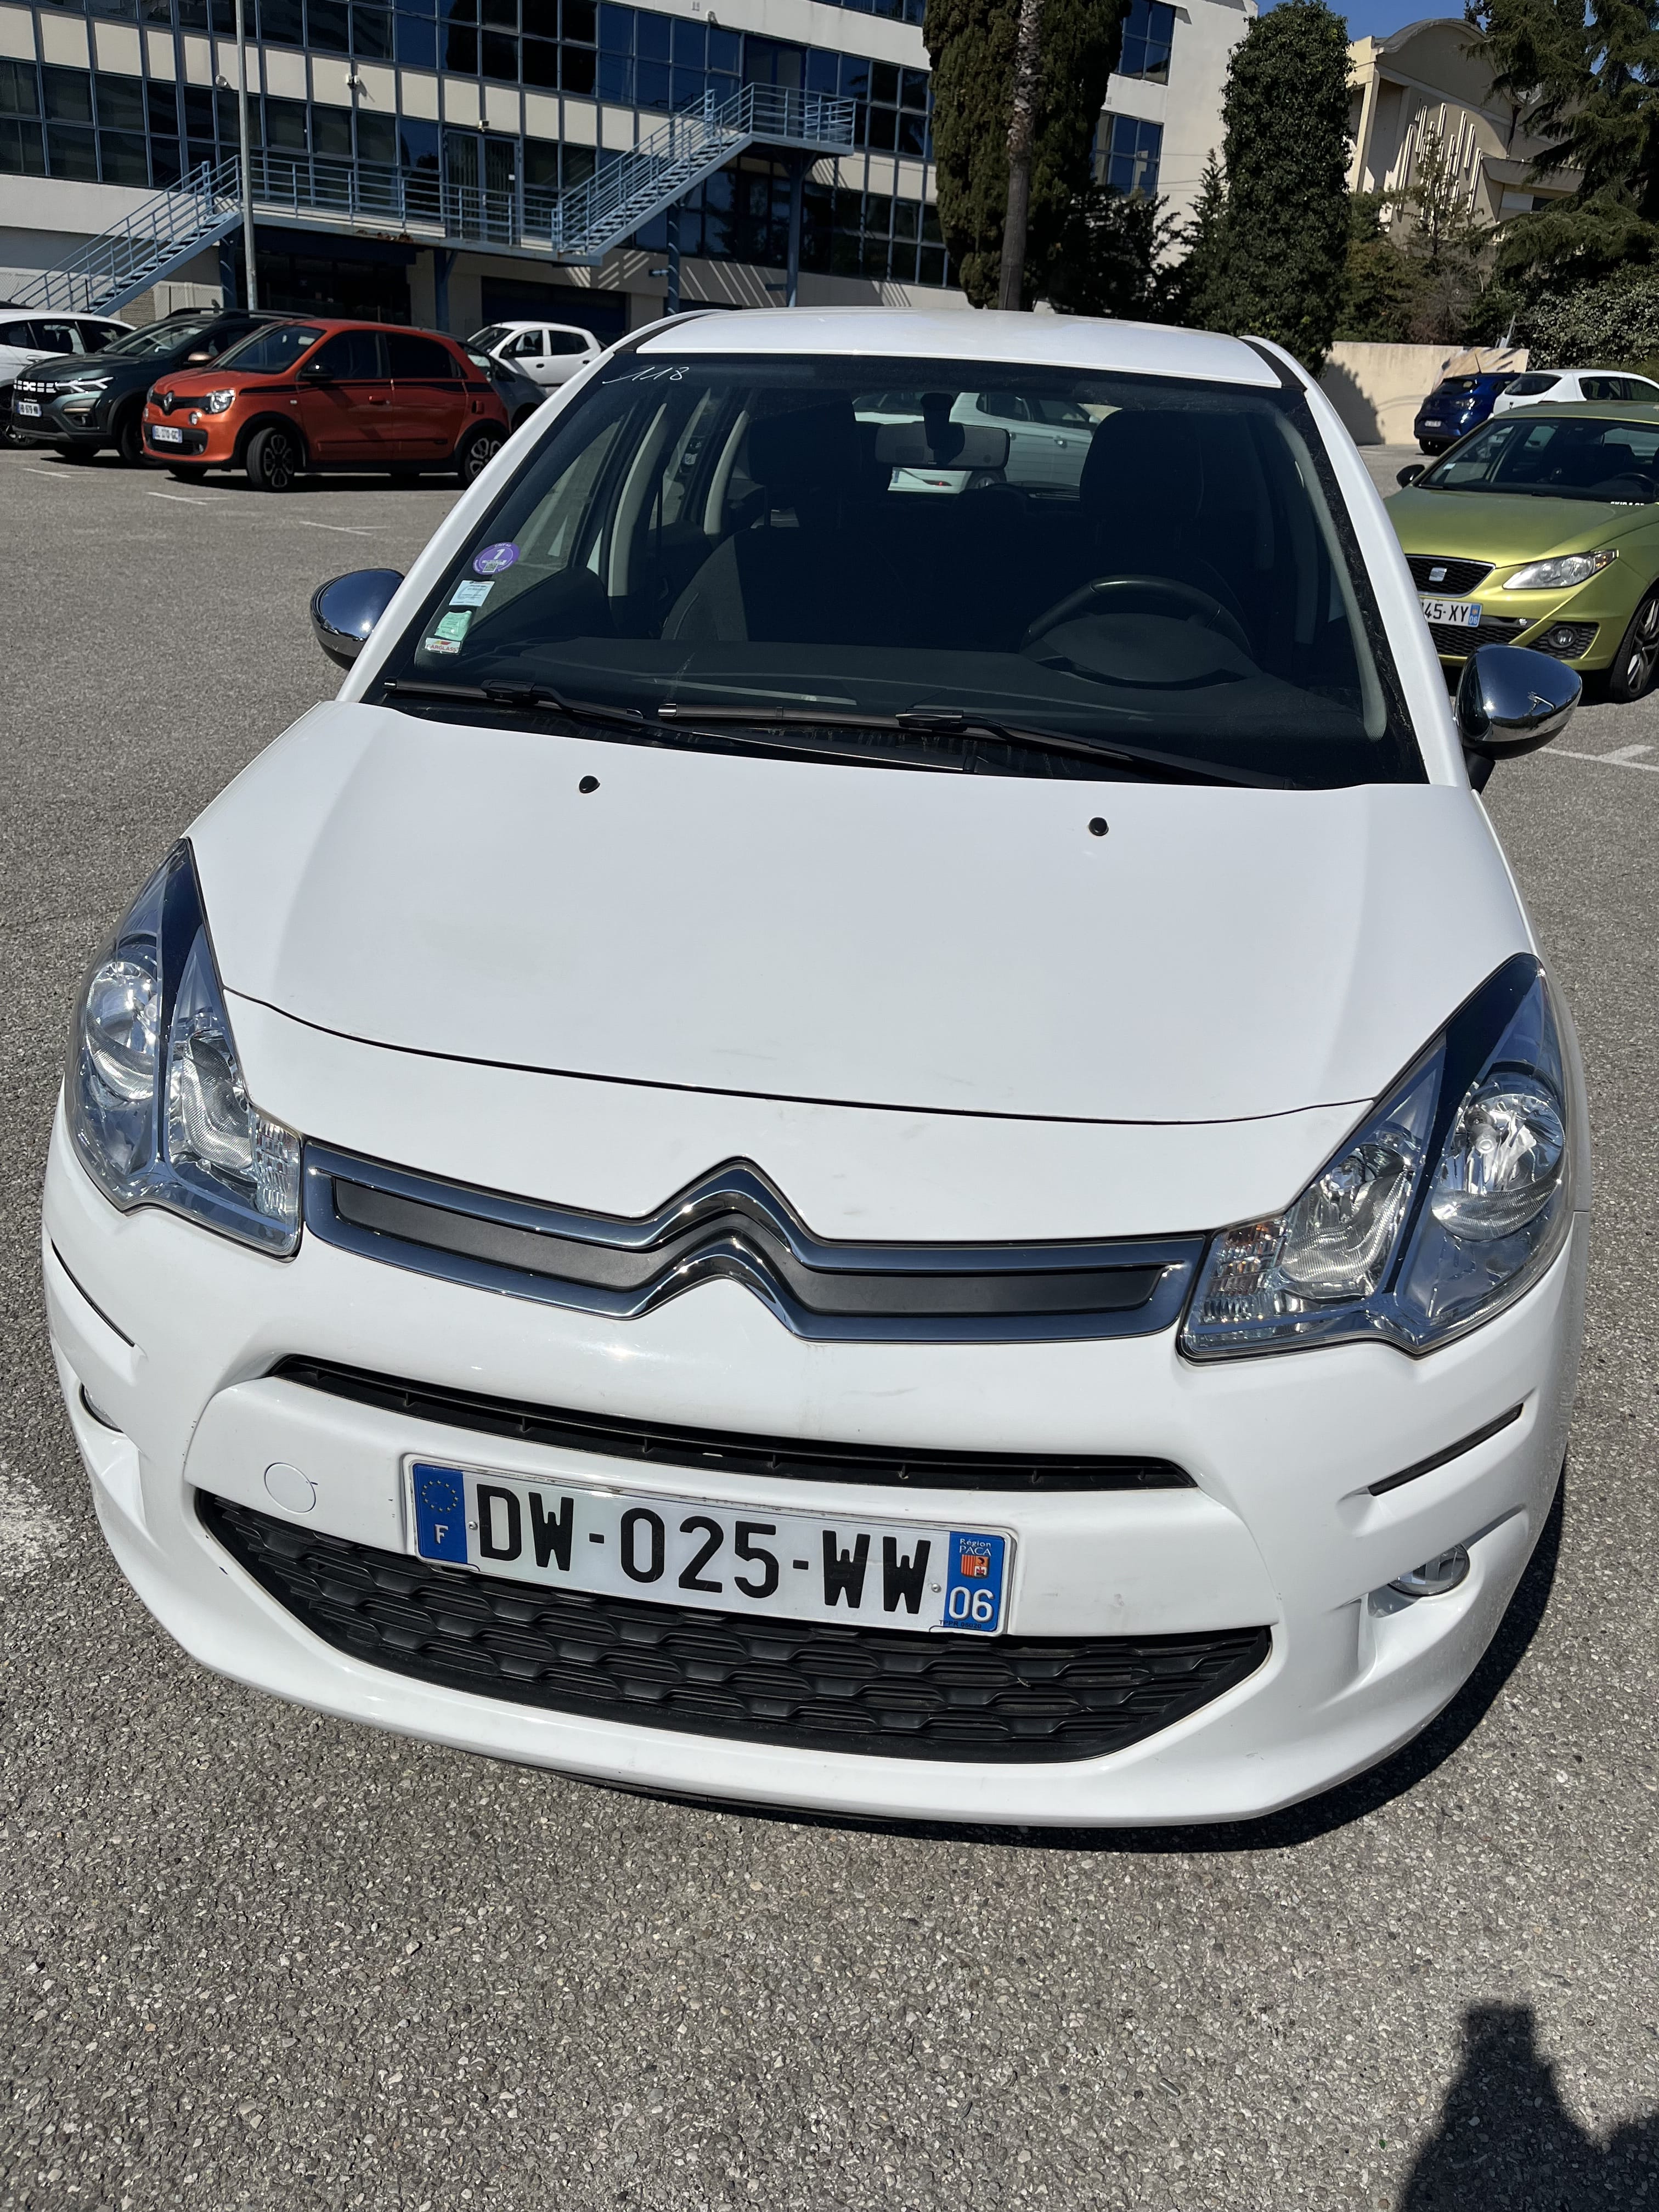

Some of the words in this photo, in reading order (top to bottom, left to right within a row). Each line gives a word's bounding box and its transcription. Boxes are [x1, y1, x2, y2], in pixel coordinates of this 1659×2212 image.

[494, 549, 505, 560] 1
[1422, 602, 1469, 622] 45-XY
[1469, 616, 1478, 624] 06
[435, 1523, 449, 1544] F
[476, 1483, 932, 1615] DW-025-WW
[959, 1545, 992, 1556] PACA
[960, 1538, 992, 1548] Région
[948, 1586, 995, 1623] 06
